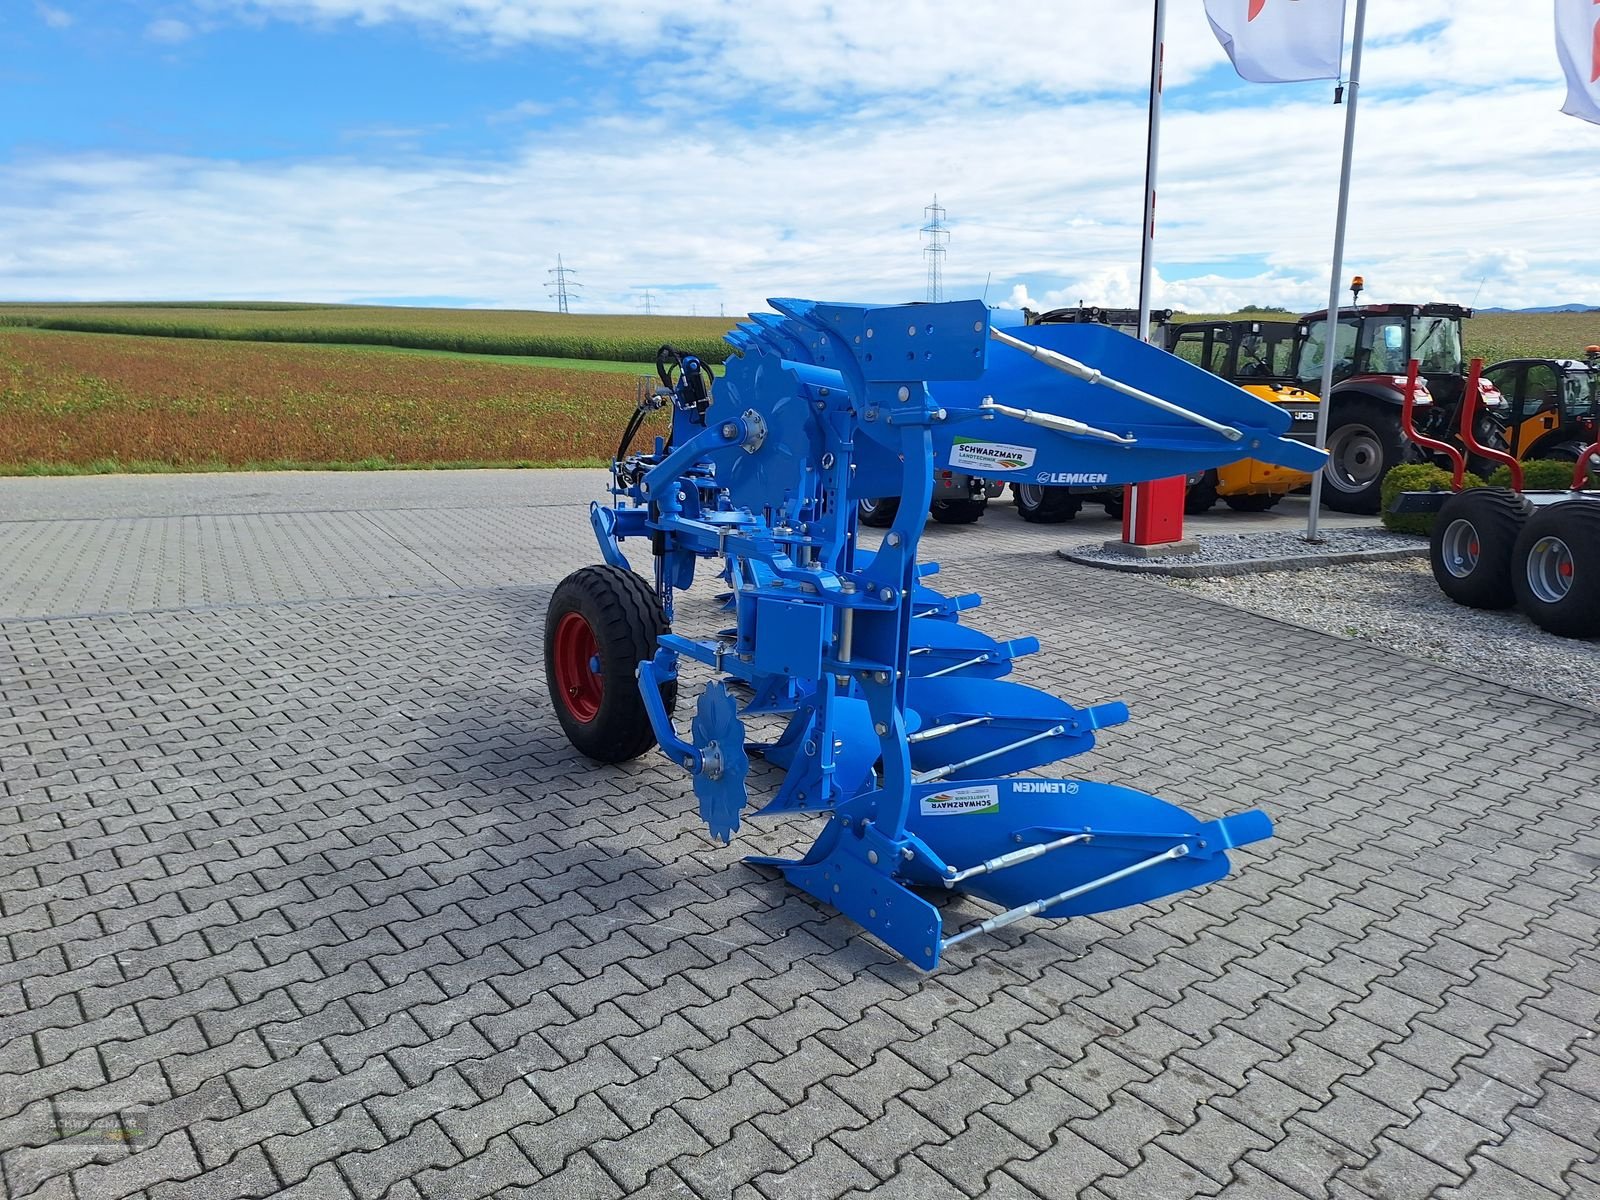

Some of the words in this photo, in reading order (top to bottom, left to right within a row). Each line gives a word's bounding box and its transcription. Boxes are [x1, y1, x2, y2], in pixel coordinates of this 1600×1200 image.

[1295, 412, 1314, 420] JCB
[959, 444, 1023, 460] SCHWARZMAYR
[959, 453, 996, 462] LANDTECHNIK
[1050, 472, 1108, 484] LEMKEN
[1012, 782, 1066, 793] LEMKEN
[931, 800, 992, 809] SCHWARZMAYR
